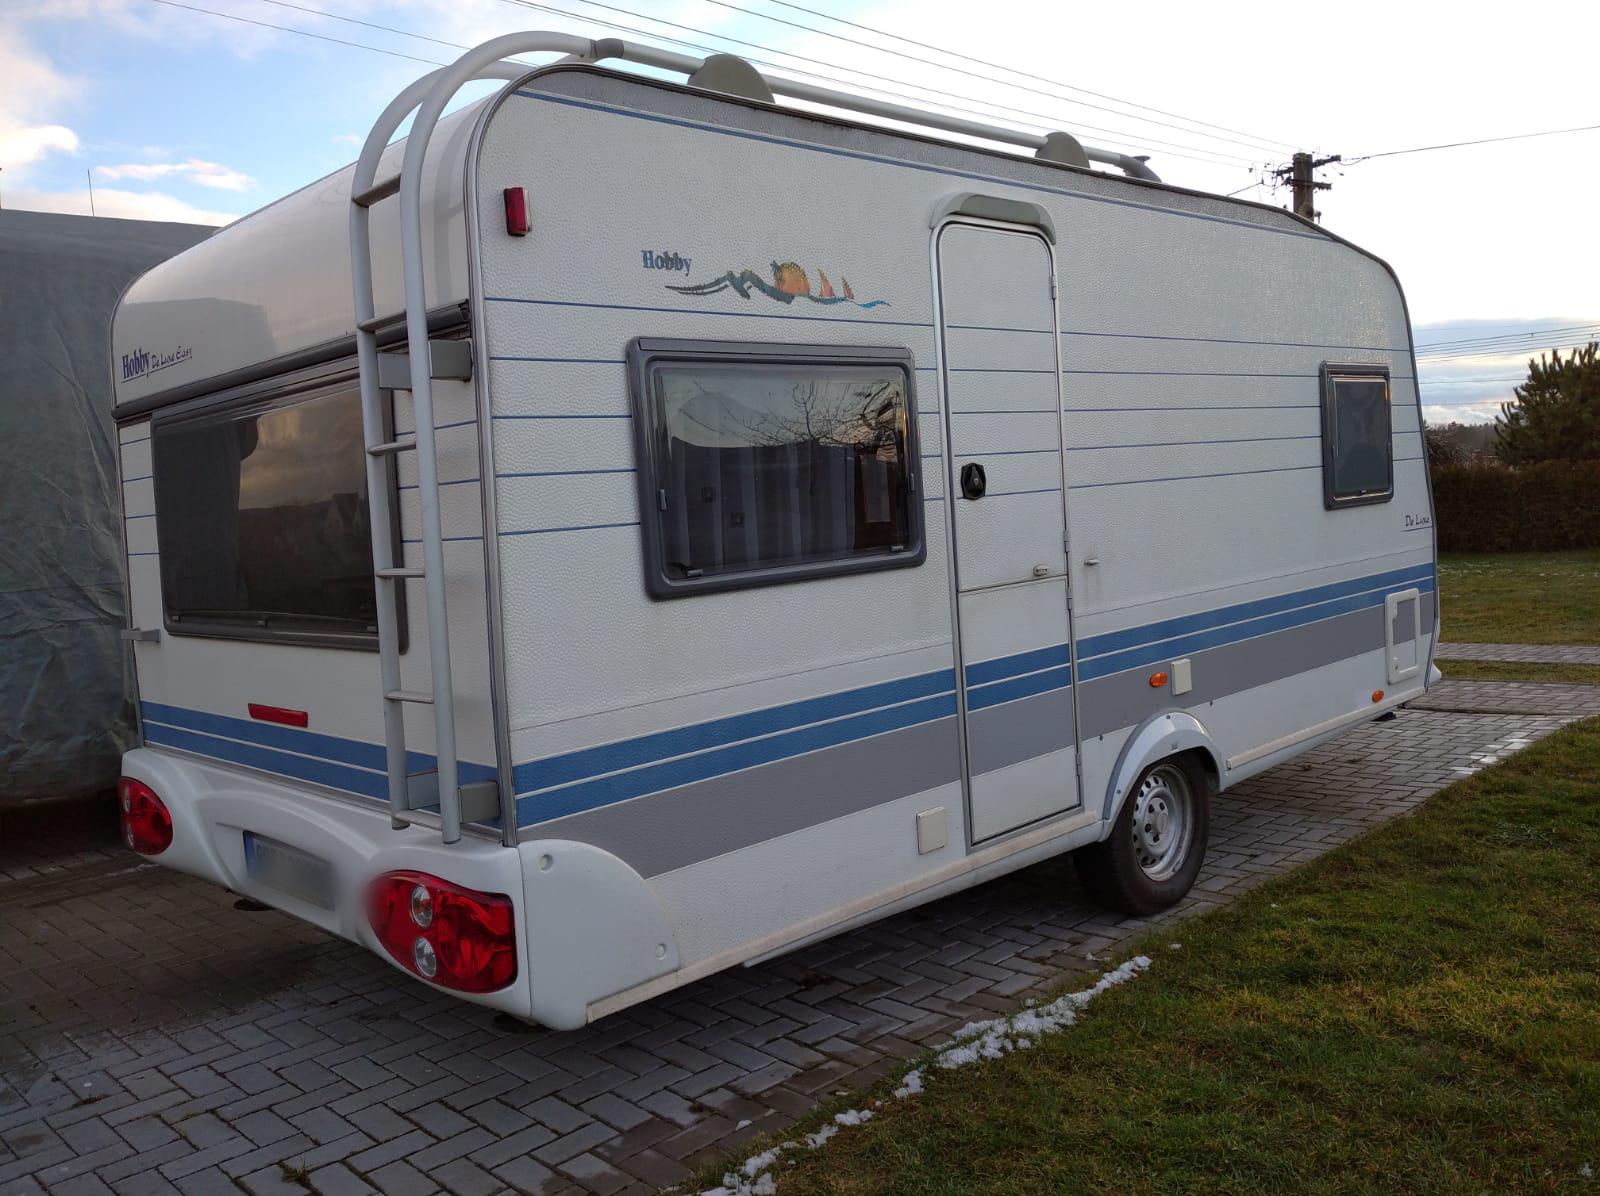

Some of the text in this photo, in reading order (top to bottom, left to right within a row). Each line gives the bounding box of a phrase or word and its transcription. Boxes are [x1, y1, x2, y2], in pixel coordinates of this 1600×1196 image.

[640, 249, 692, 277] Hobby
[122, 347, 150, 378] Hobby
[151, 354, 160, 369] De
[1405, 514, 1414, 527] De
